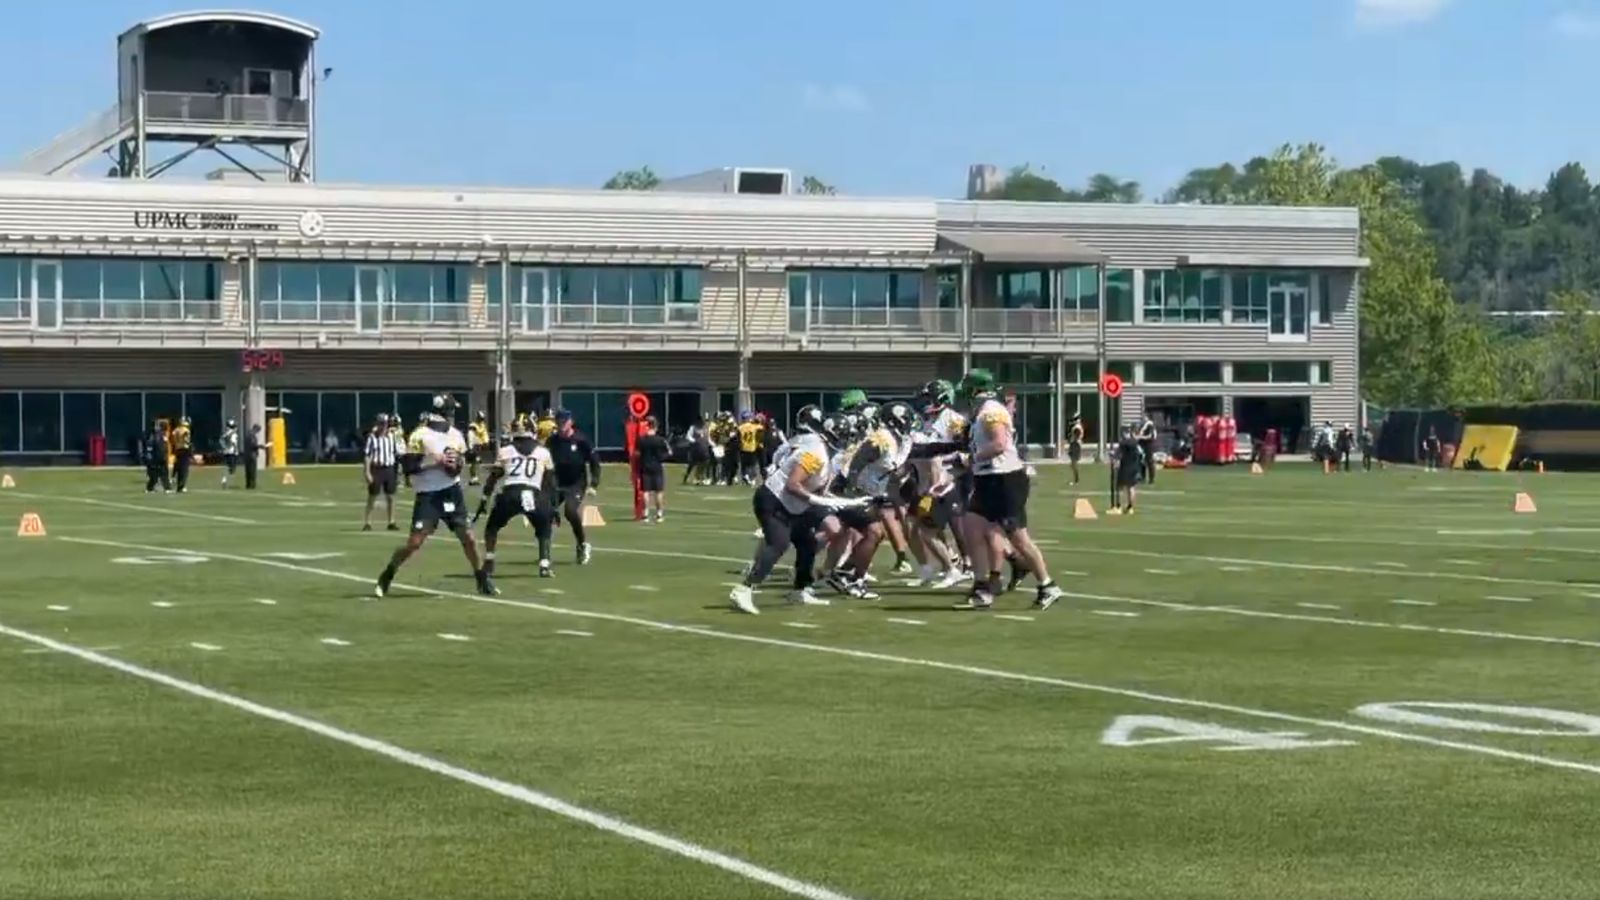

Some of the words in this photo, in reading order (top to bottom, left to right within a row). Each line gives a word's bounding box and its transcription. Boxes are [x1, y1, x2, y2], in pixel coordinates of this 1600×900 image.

[134, 211, 198, 229] UPMC
[237, 222, 279, 231] COMPLEX
[510, 457, 537, 478] 20
[24, 517, 39, 533] 20
